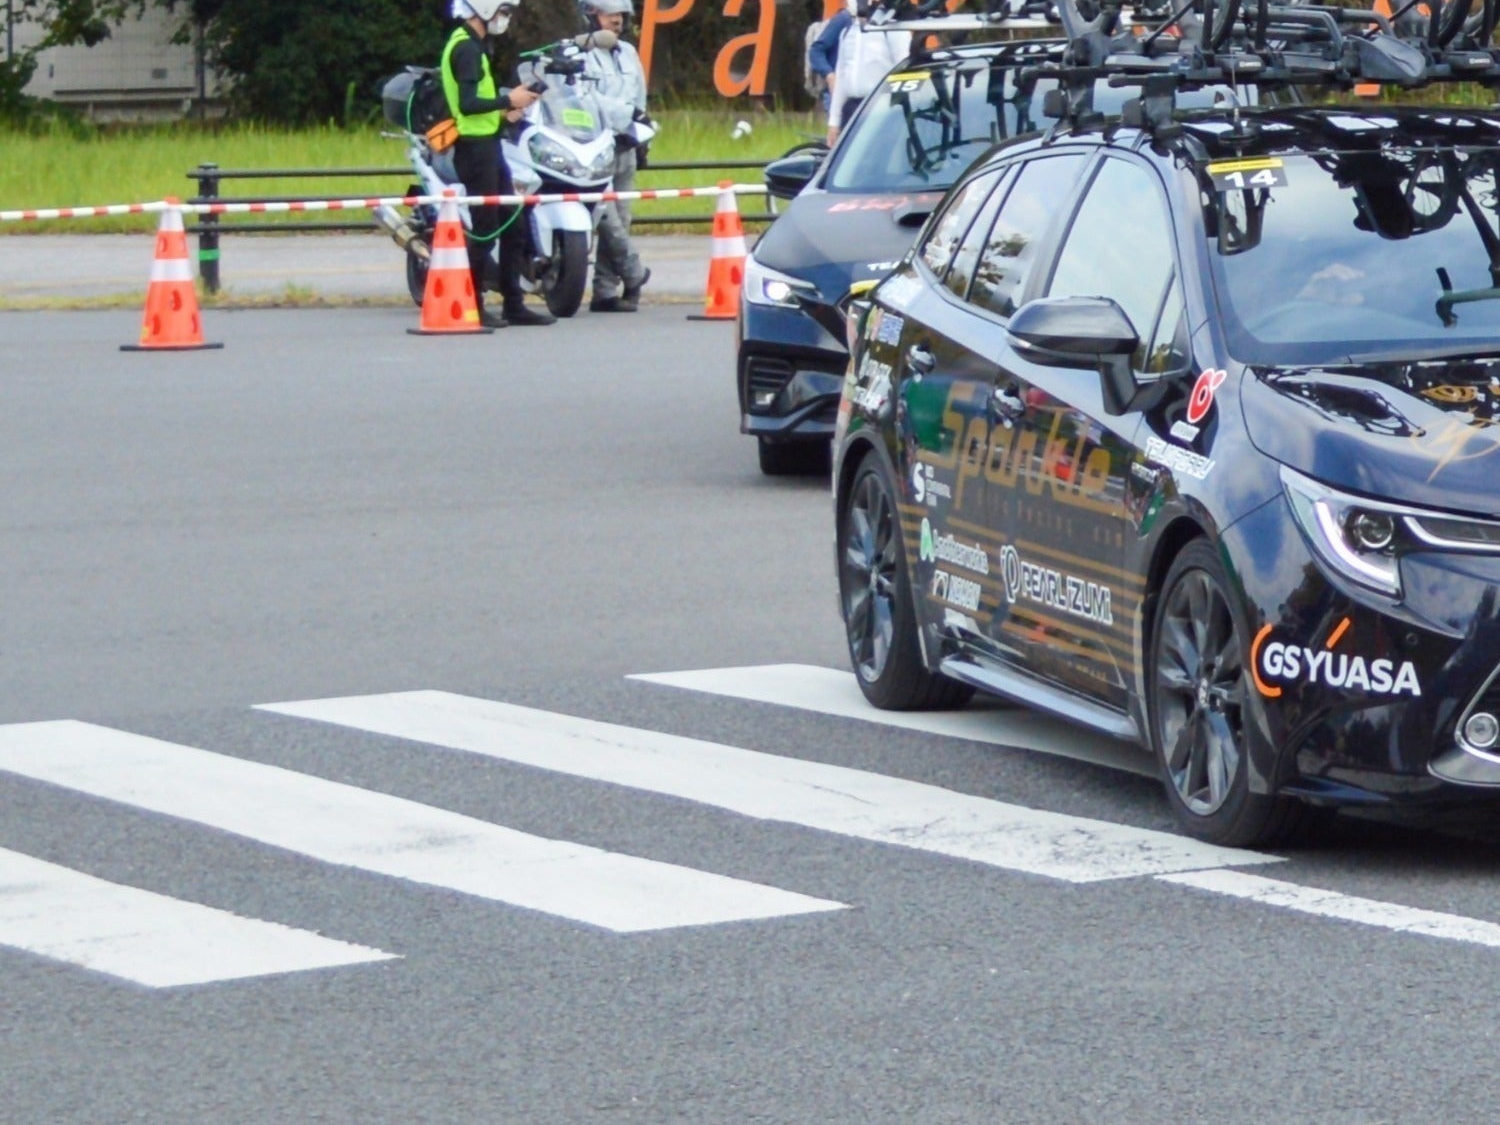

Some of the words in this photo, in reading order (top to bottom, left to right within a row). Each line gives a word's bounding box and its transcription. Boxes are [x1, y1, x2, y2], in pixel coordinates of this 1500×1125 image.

[889, 80, 919, 93] 15
[1224, 169, 1278, 188] 14
[1021, 560, 1067, 610] PEARL
